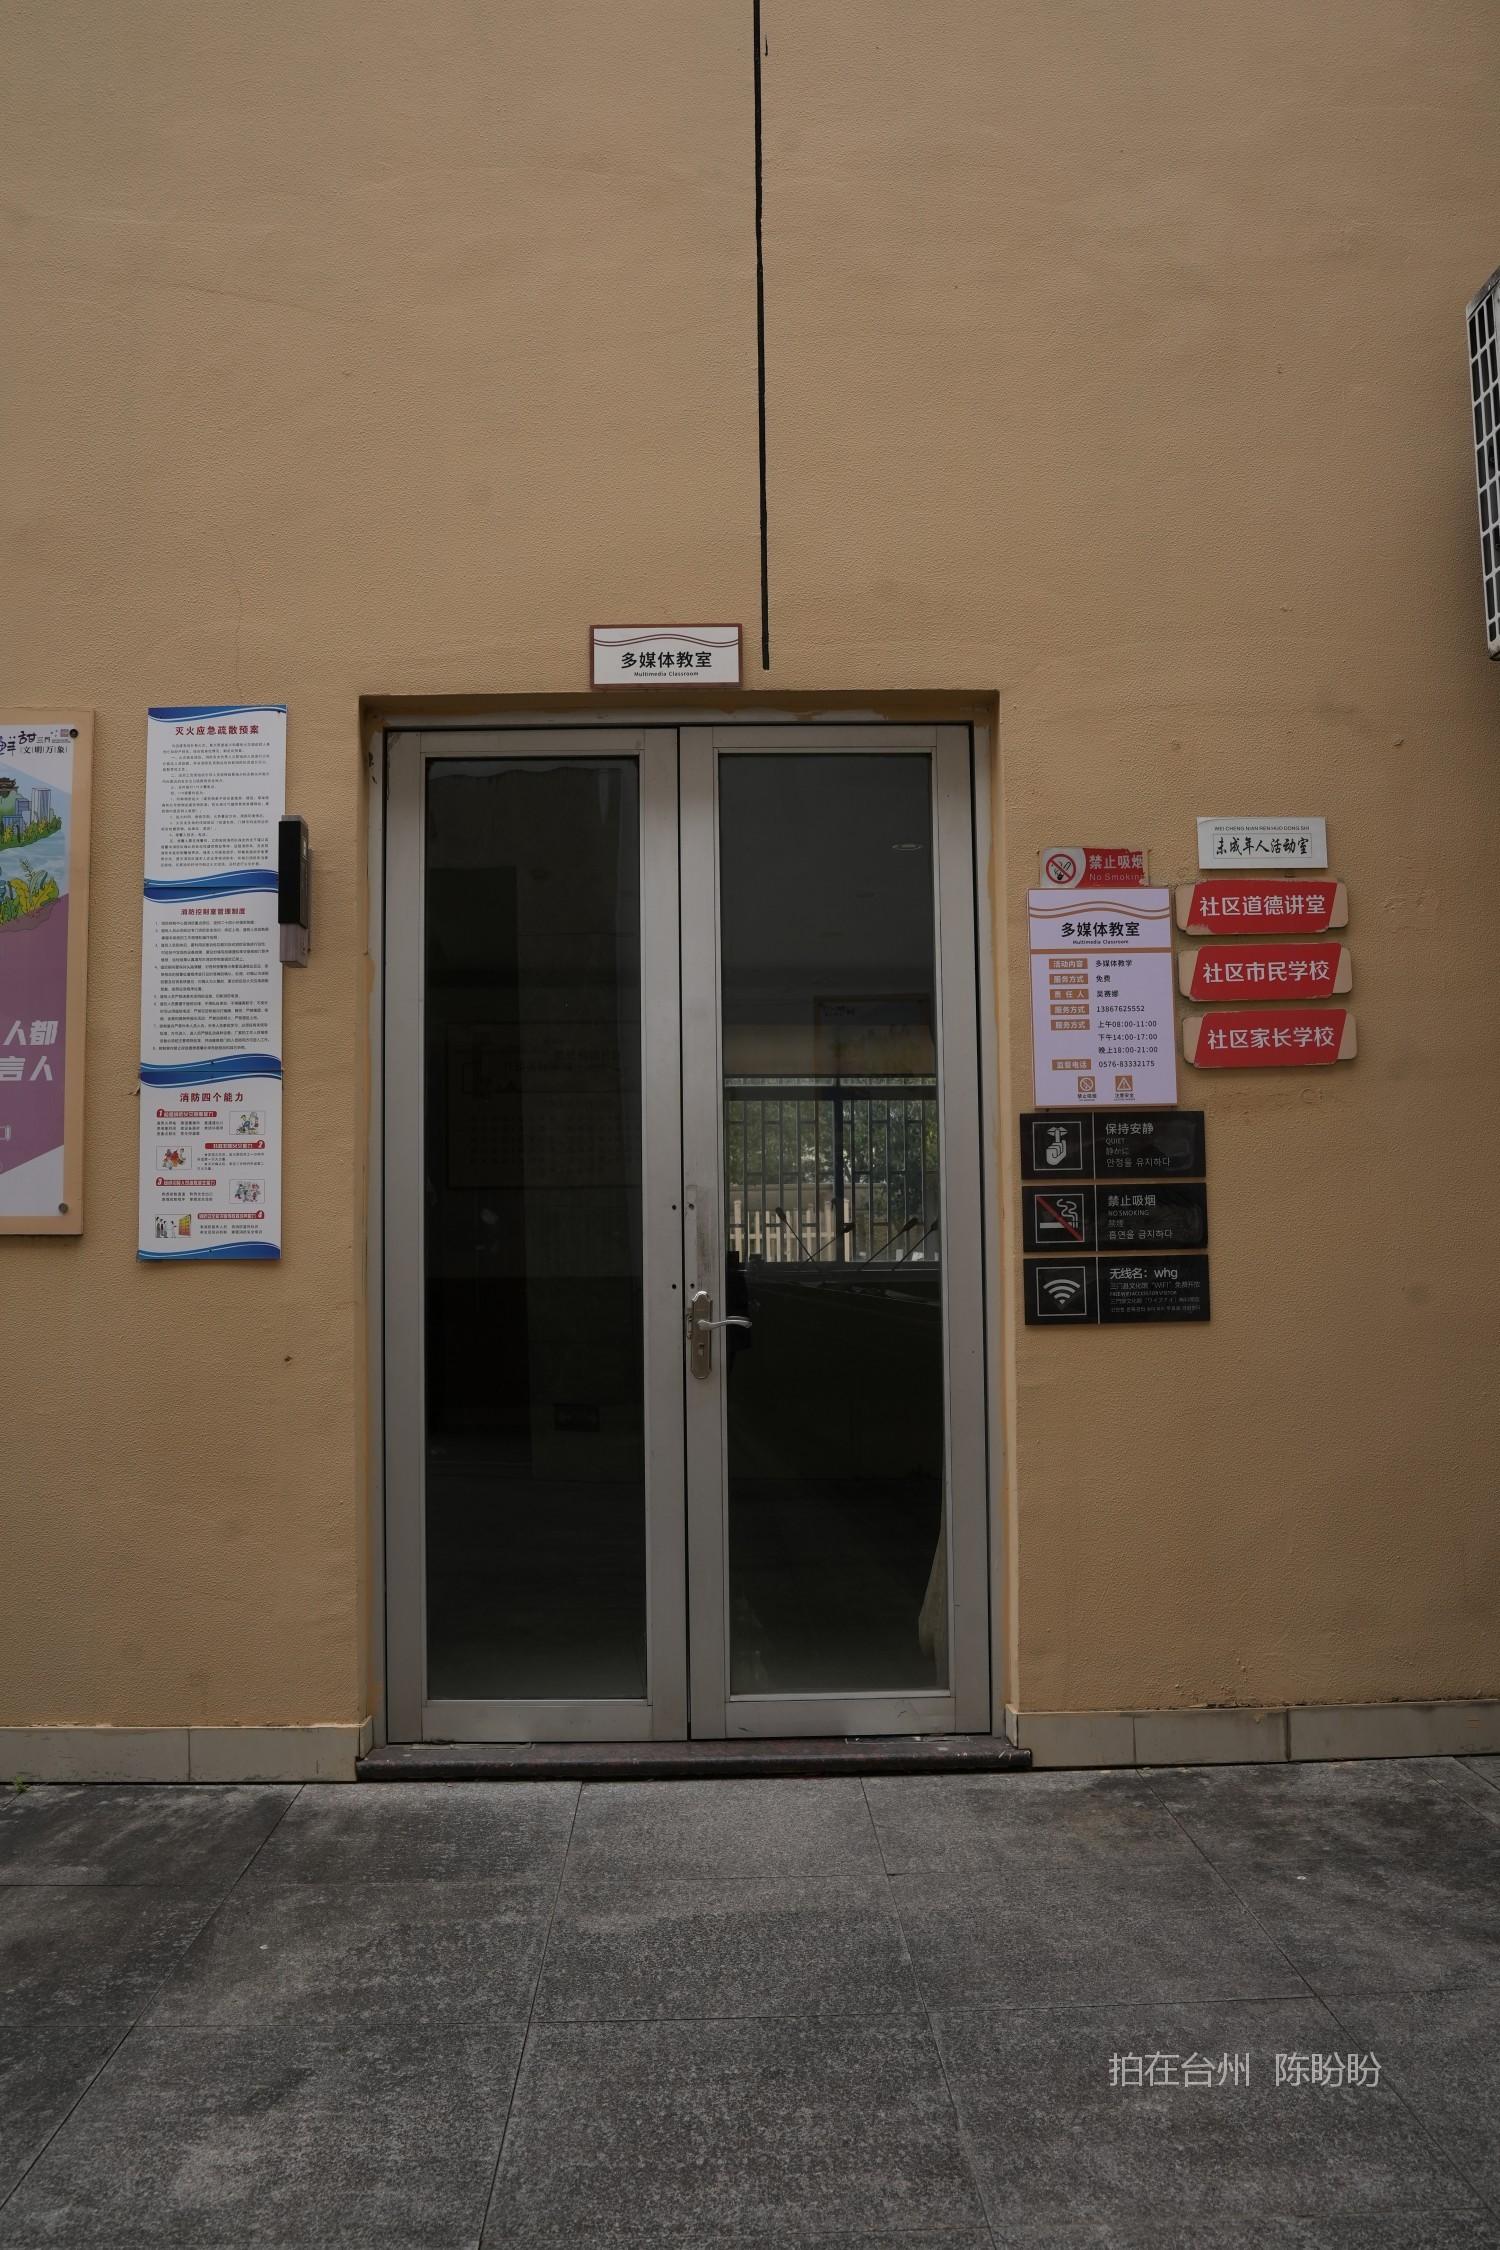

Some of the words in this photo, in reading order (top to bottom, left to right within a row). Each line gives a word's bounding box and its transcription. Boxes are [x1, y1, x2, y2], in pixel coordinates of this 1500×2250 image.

[621, 651, 712, 669] 多媒体教室
[175, 724, 260, 736] 灭火应急疏散预案
[1216, 836, 1309, 856] 未成年人活动室
[1089, 854, 1144, 870] 禁止吸烟
[1199, 894, 1326, 917] 社区道德讲堂
[1061, 921, 1140, 938] 多媒体教室
[1053, 960, 1083, 968] 活动内容
[1095, 959, 1133, 968] 多媒体教学
[1096, 974, 1111, 983] 免费
[1202, 960, 1331, 983] 社区市民学校
[1053, 975, 1085, 984] 服务方式
[3, 1020, 58, 1046] 人都
[1207, 1026, 1336, 1050] 社区家长学校
[179, 1092, 245, 1103] 消防四个能力
[1105, 1122, 1154, 1135] 保持安静
[1107, 1194, 1156, 1207] 禁止吸烟
